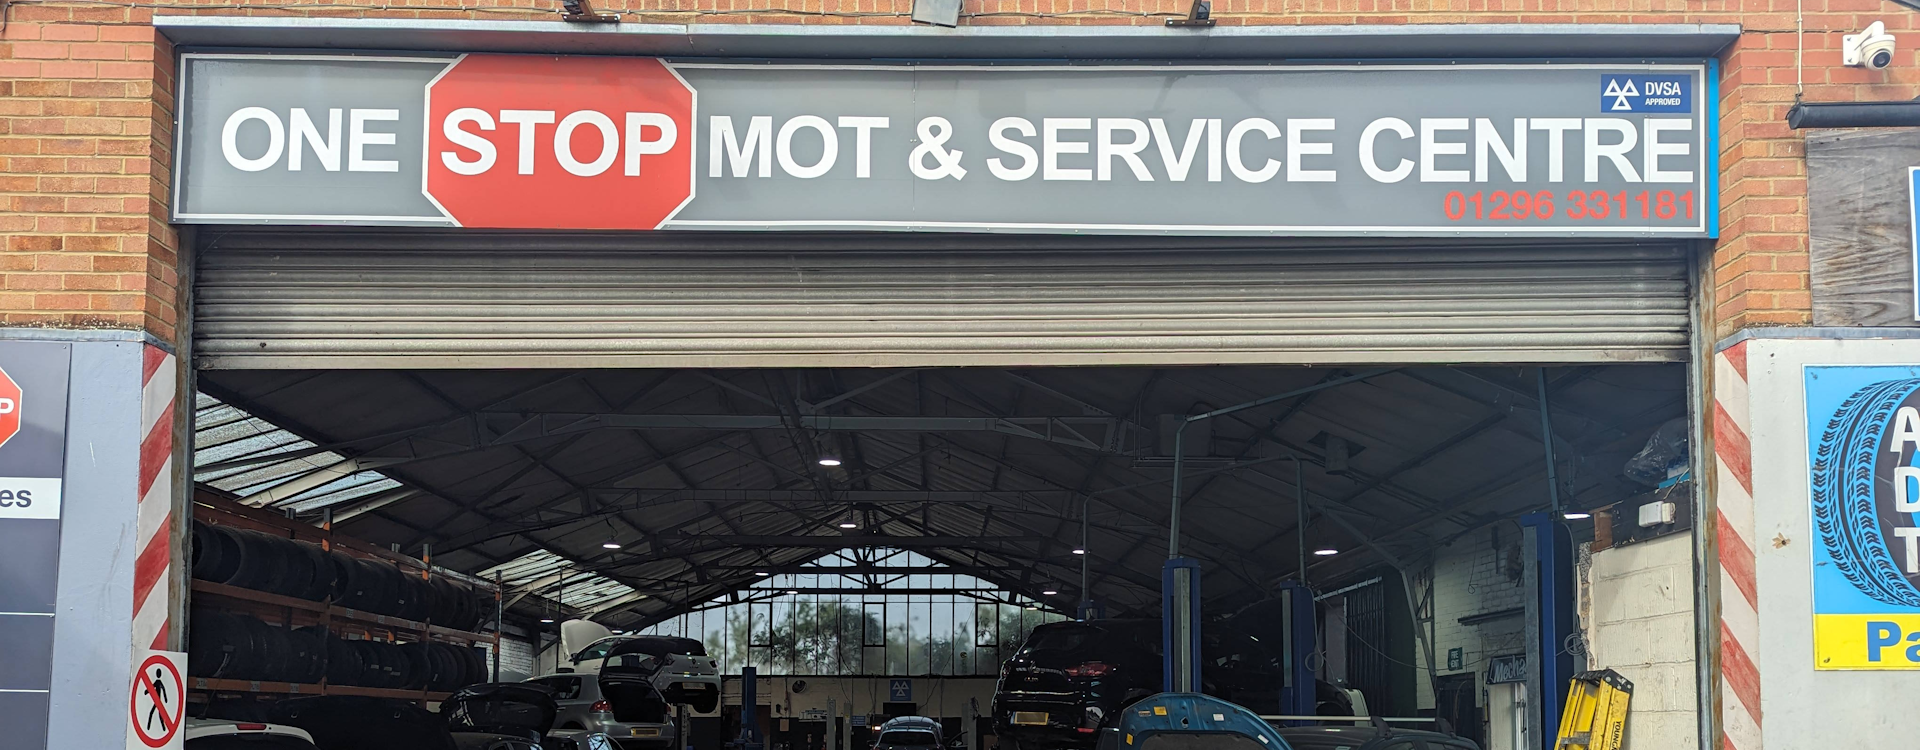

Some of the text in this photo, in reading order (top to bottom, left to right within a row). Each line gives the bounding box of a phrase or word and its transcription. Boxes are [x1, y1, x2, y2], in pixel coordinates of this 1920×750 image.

[1645, 81, 1682, 96] DVSA
[1645, 97, 1681, 106] APPROVED
[221, 106, 1694, 184] ONE STOP MOT & SERVICE CENTRE
[1444, 190, 1693, 220] 01296 331181
